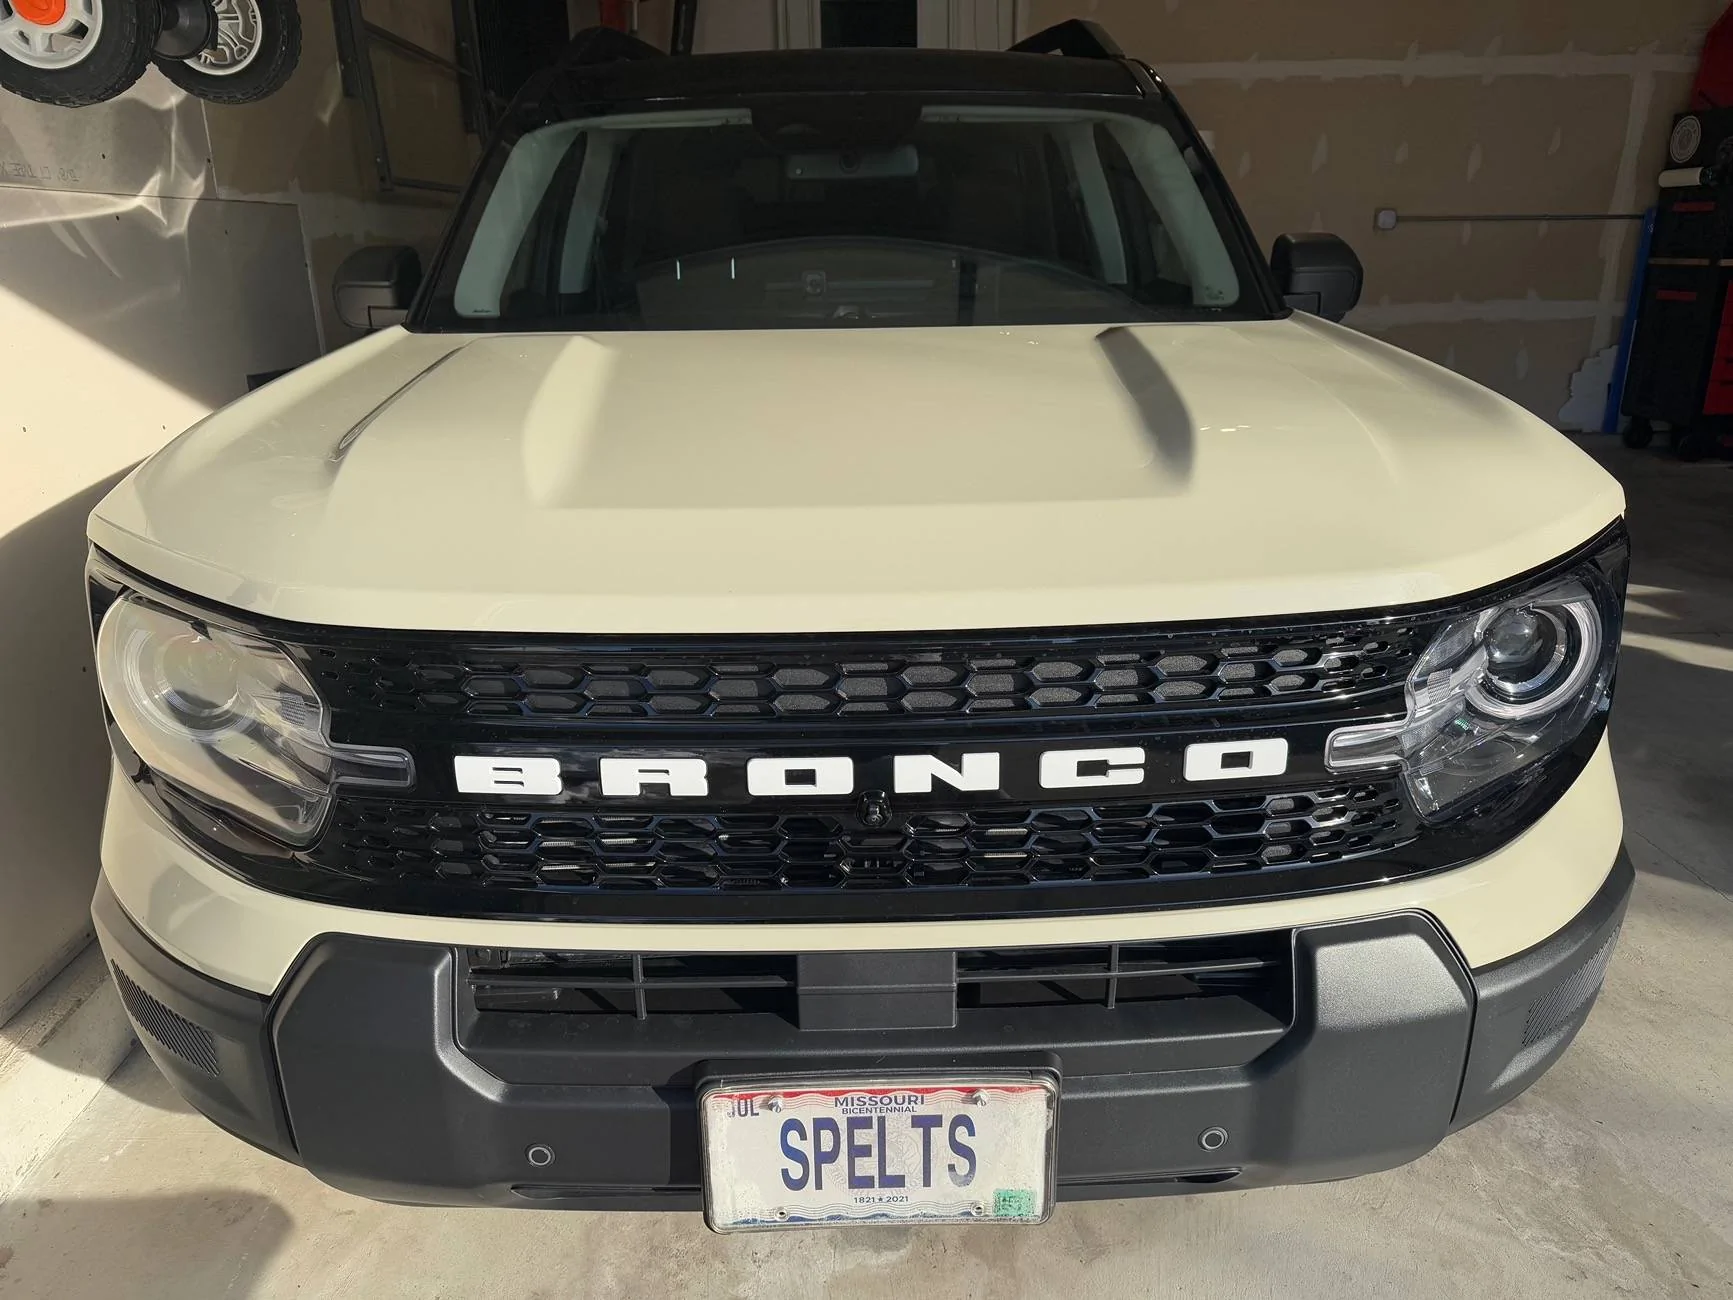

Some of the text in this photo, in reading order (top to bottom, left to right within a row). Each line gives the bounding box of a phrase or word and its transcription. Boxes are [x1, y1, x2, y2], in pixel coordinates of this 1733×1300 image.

[454, 737, 1289, 797] BRONCO
[727, 1099, 760, 1118] JUL
[834, 1094, 926, 1108] MISSOURI
[841, 1105, 918, 1115] BICENTENNIAL
[779, 1114, 978, 1192] SPELTS
[853, 1195, 910, 1204] 1821 2021
